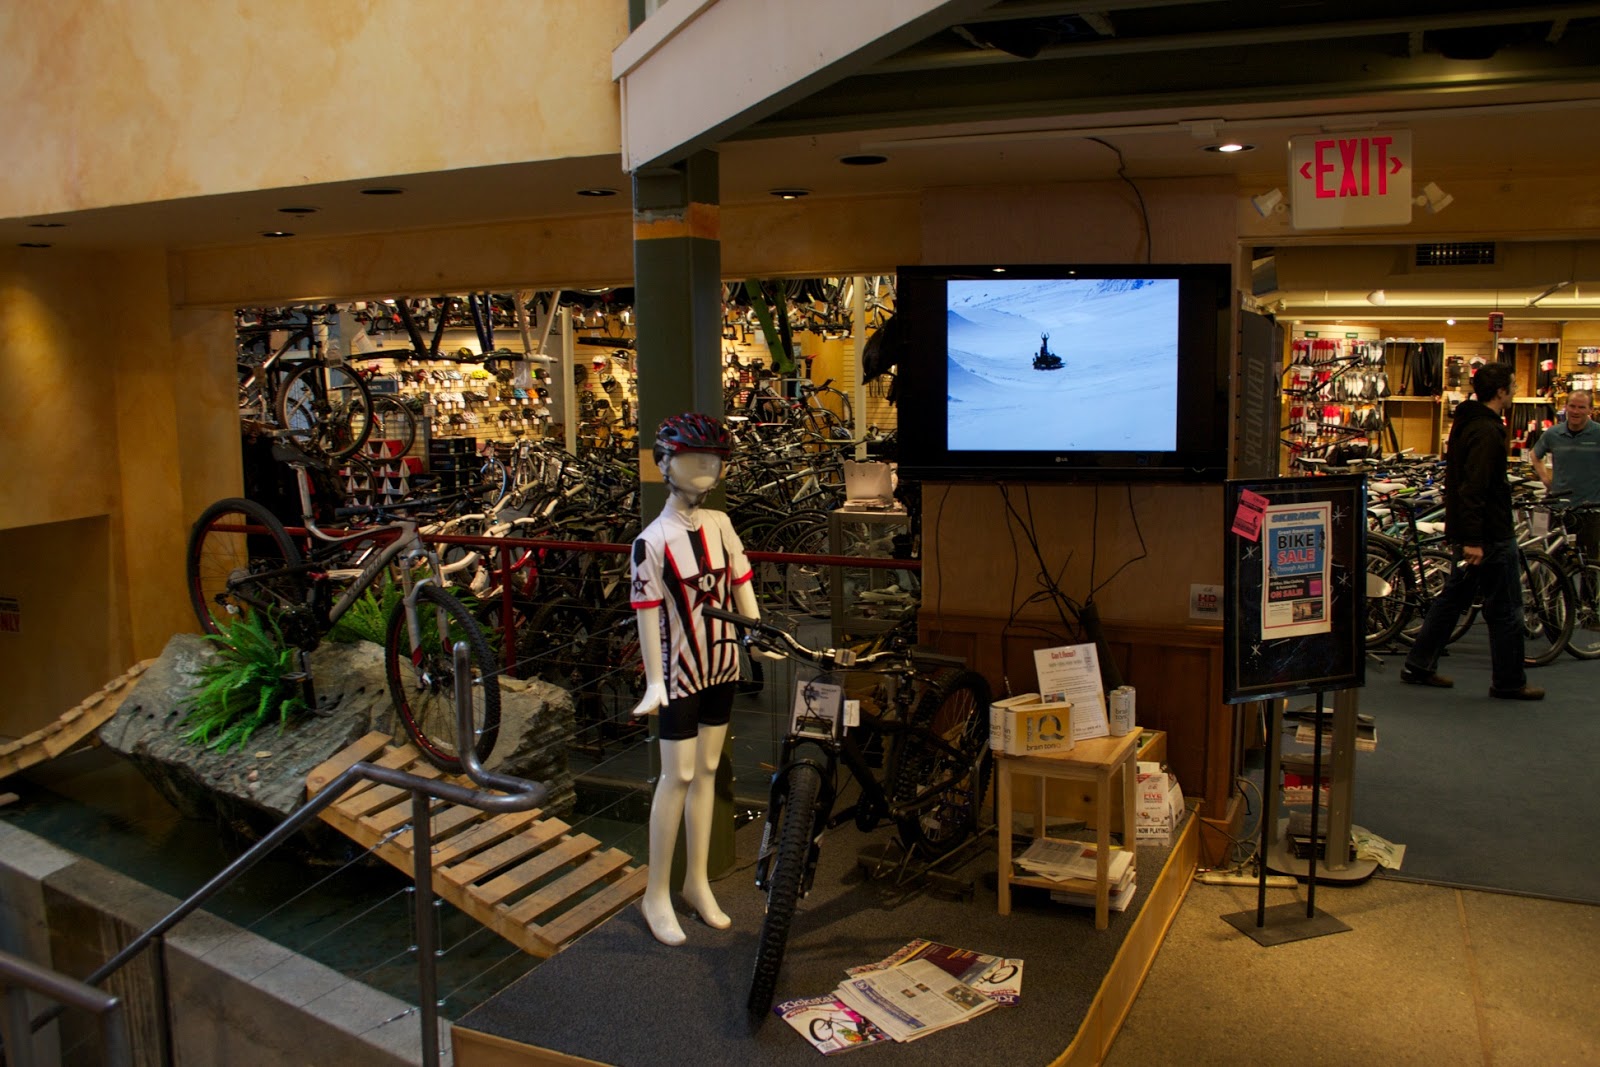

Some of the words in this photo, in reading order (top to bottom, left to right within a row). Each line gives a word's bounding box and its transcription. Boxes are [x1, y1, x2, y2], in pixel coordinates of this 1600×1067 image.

[1314, 137, 1393, 198] EXIT
[1245, 358, 1265, 466] SPECIALIZED
[1278, 533, 1315, 549] BIKE
[1277, 548, 1315, 566] SALE
[0, 613, 19, 633] NLY
